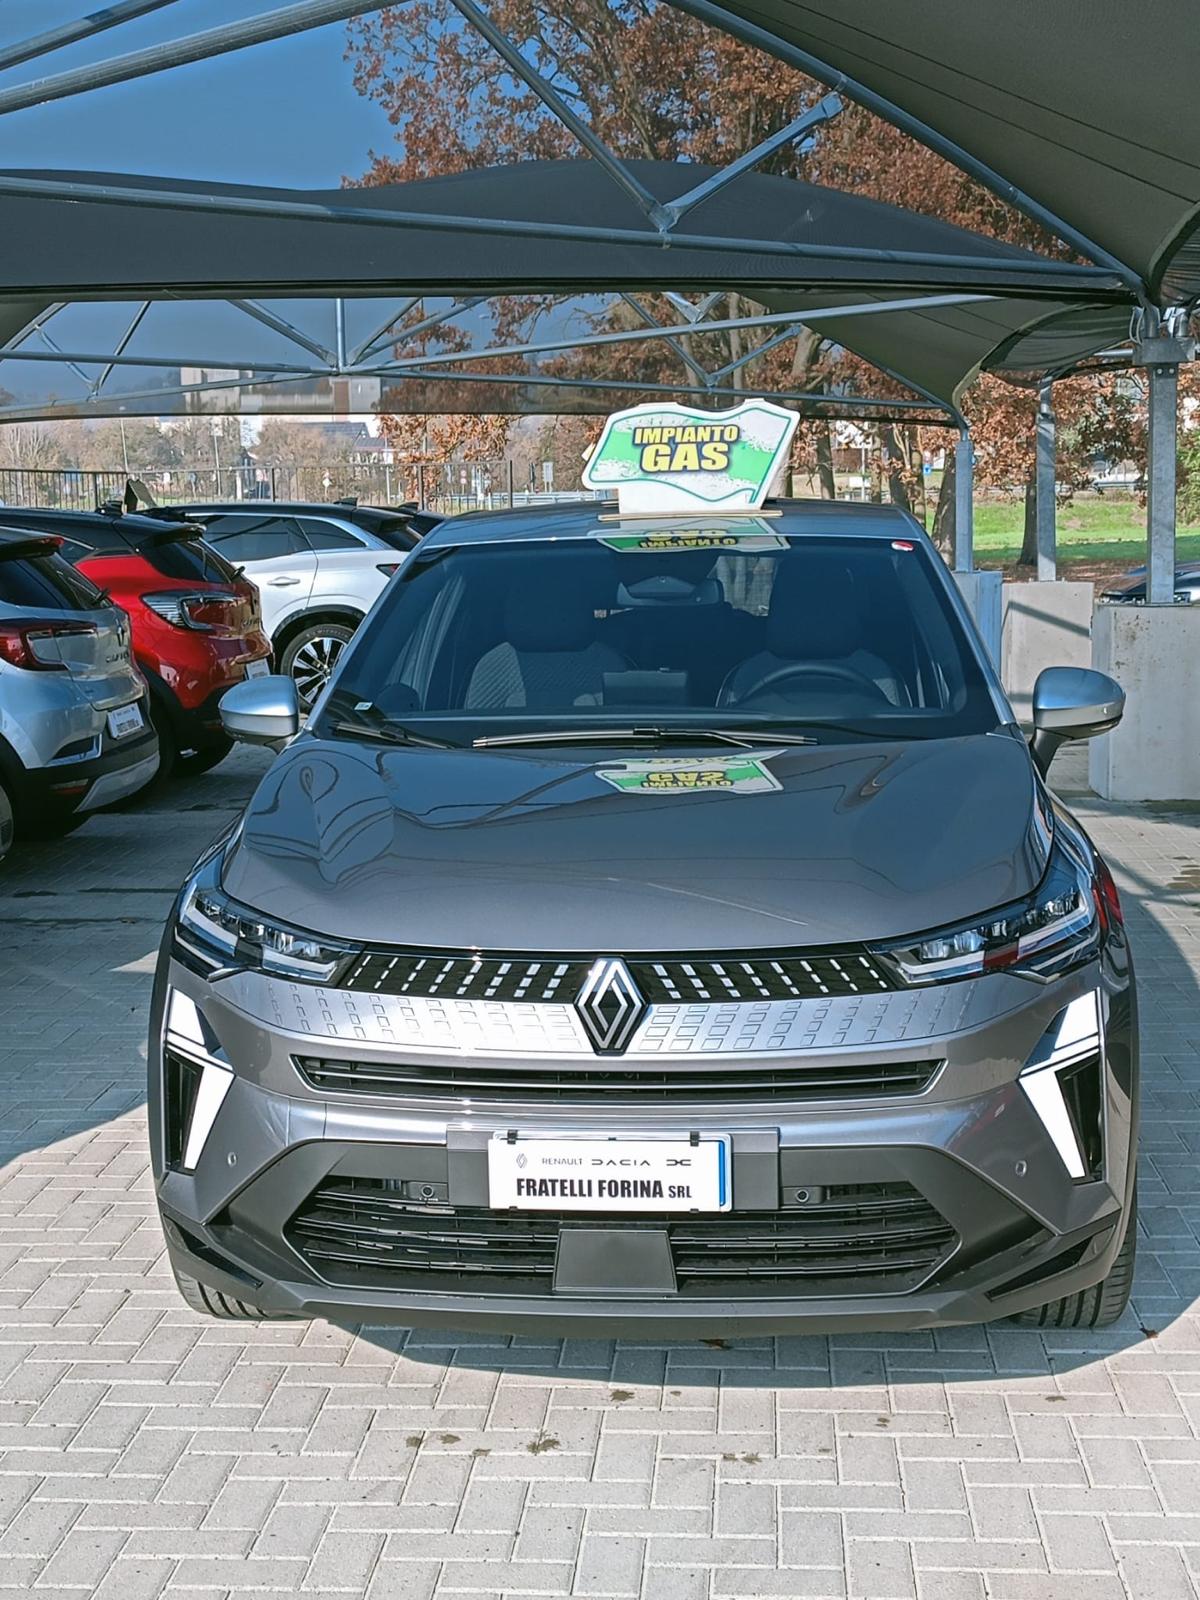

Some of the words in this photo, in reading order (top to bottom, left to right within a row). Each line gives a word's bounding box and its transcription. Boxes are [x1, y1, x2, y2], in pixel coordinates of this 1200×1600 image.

[633, 424, 740, 444] IMPIANTO
[641, 442, 729, 472] GAS
[541, 1157, 583, 1166] RENAULT
[591, 1159, 651, 1167] DACIA
[516, 1178, 592, 1198] FRATELLI
[597, 1179, 664, 1199] FORINA
[668, 1185, 692, 1199] SRL
